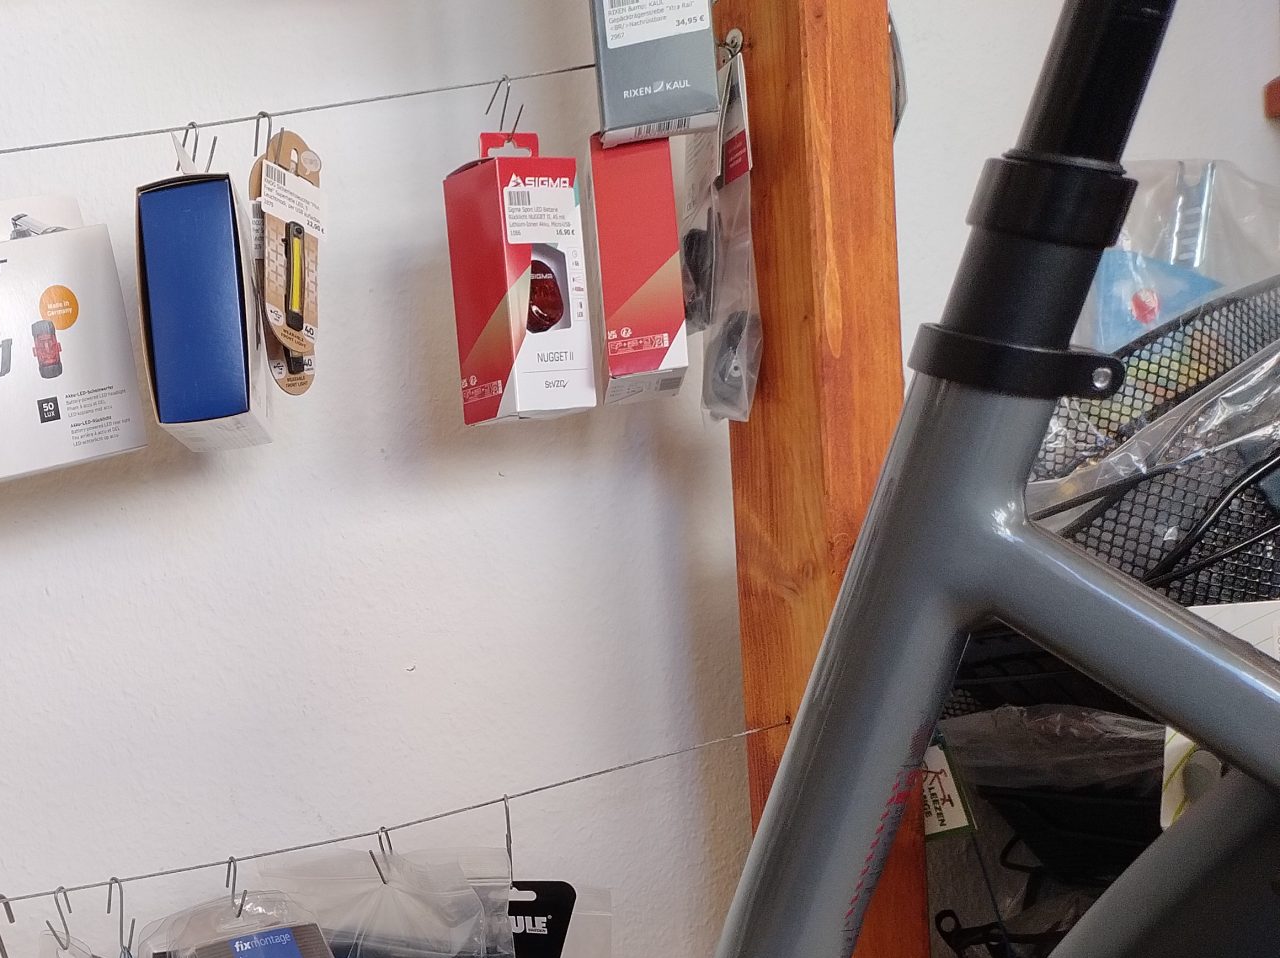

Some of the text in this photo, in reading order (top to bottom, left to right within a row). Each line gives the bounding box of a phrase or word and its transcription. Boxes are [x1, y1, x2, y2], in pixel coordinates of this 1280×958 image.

[623, 79, 692, 99] RIXEN KAUL
[304, 326, 314, 336] 40
[536, 351, 568, 363] NUGGET
[42, 402, 55, 412] 50
[43, 411, 56, 419] LUX
[234, 932, 291, 953] fixmontage
